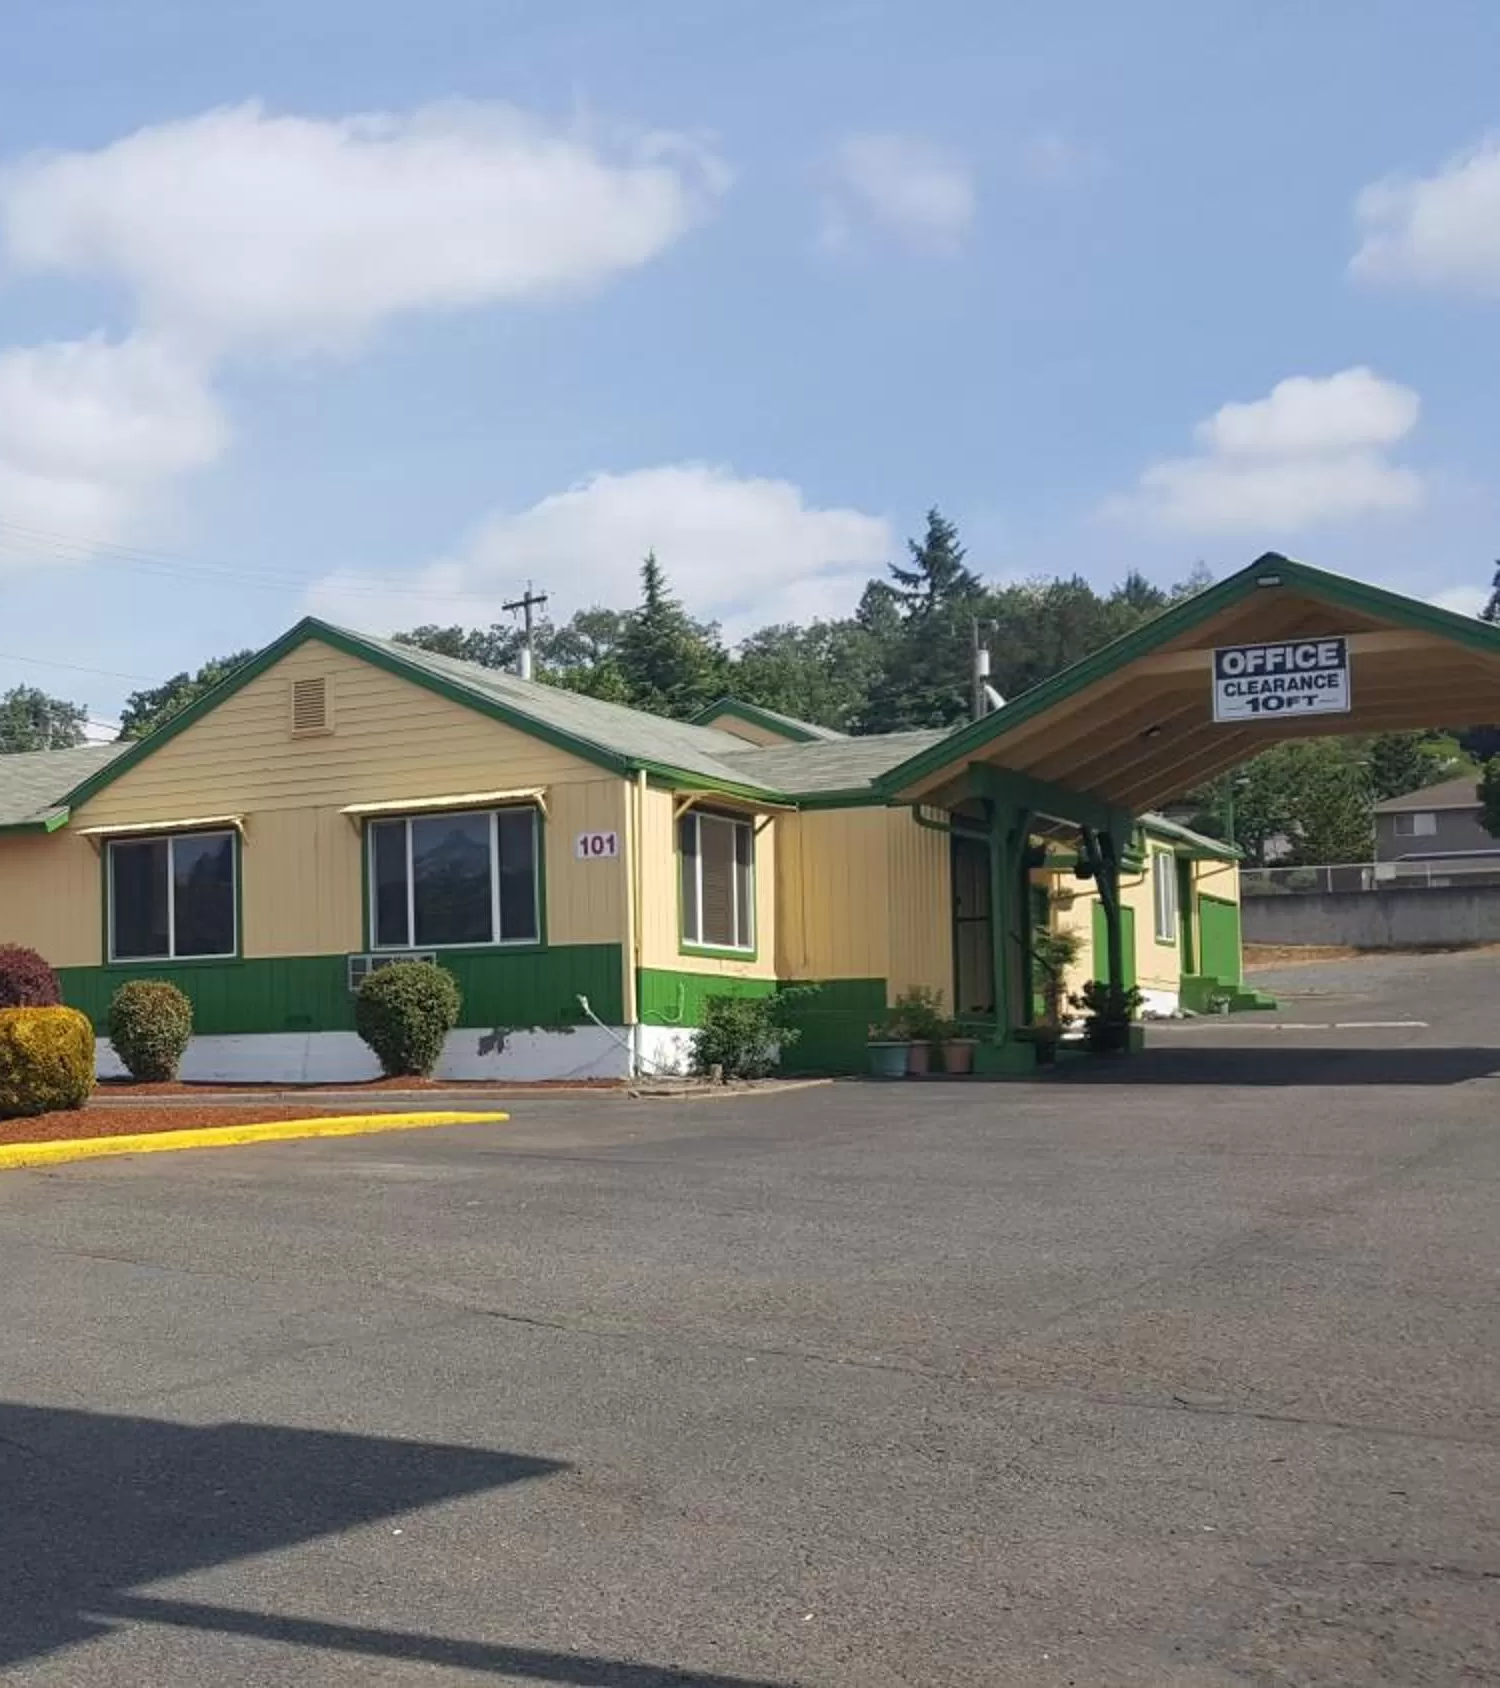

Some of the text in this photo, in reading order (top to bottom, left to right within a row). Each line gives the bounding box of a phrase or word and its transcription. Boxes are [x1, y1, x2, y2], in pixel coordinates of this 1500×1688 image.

[1222, 642, 1340, 675] OFFICE
[1224, 674, 1339, 697] CLEARANCE
[1246, 695, 1318, 712] 10FT
[580, 834, 614, 855] 101
